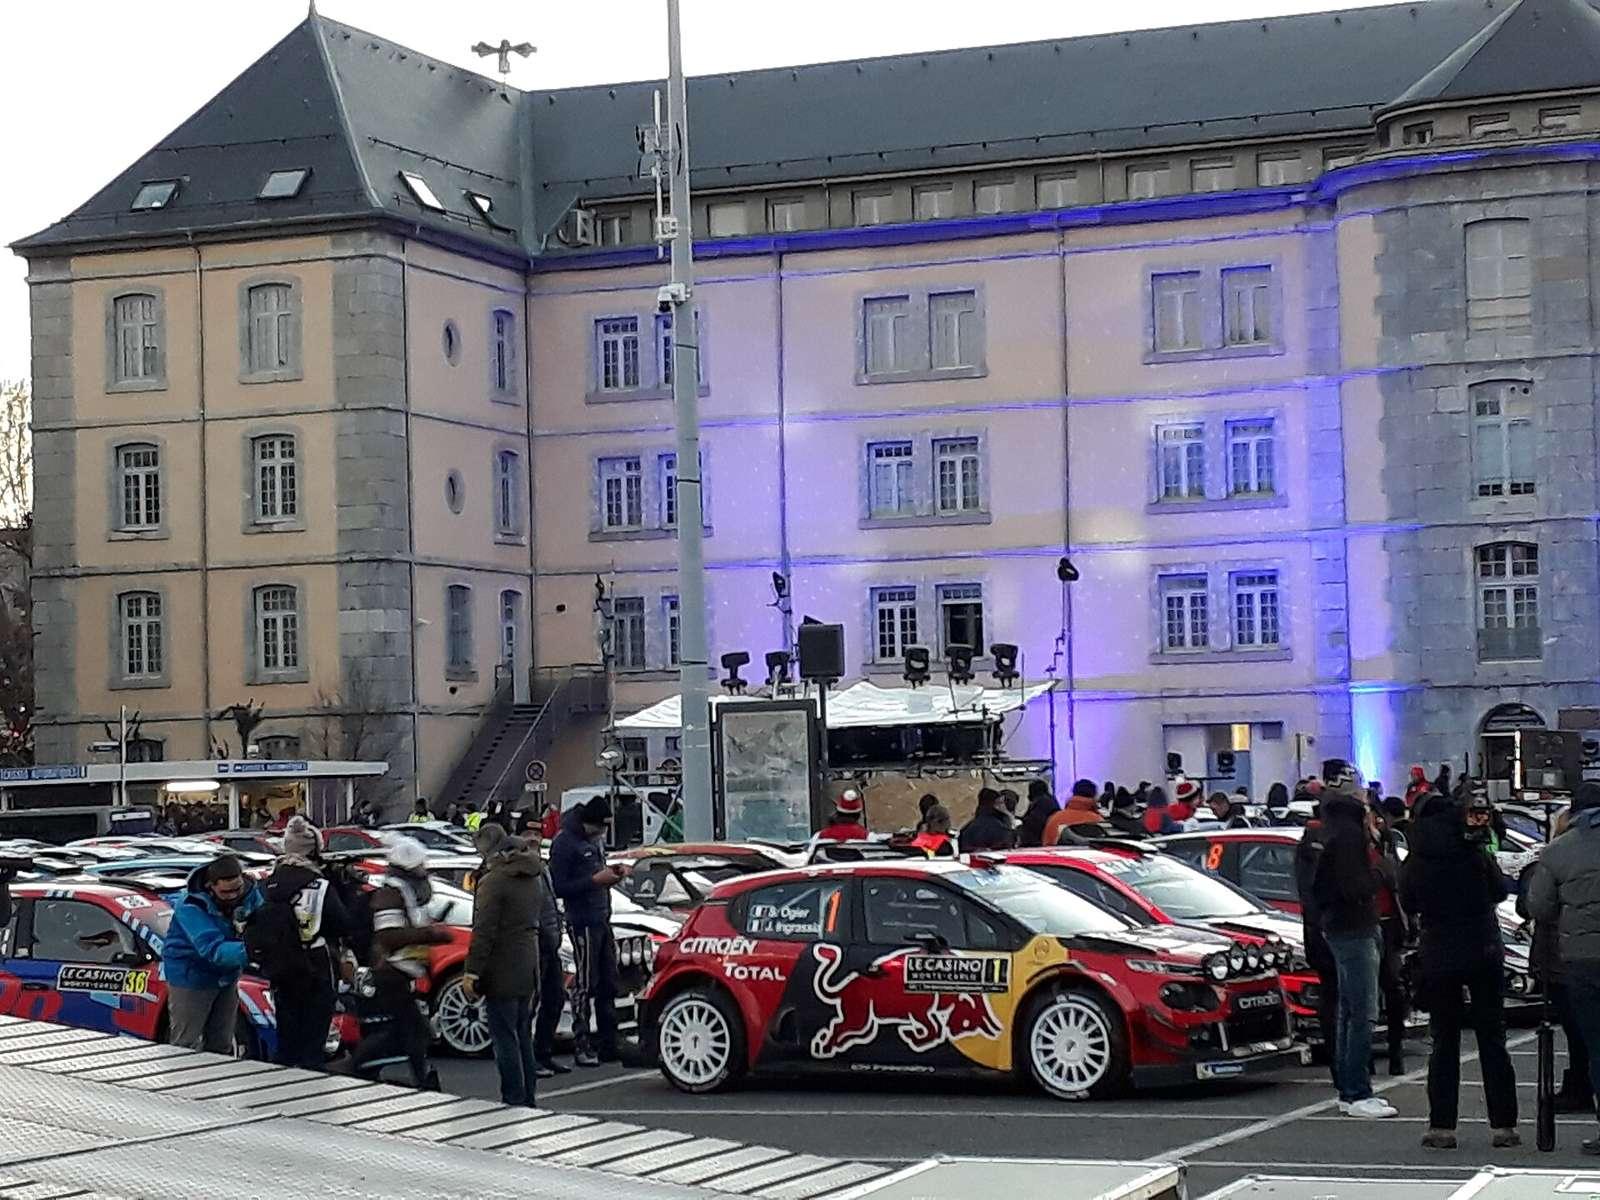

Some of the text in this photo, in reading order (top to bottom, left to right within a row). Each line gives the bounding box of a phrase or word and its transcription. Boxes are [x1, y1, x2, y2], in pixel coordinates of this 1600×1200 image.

[1205, 842, 1223, 870] 8
[780, 906, 810, 921] Ogier
[828, 891, 842, 933] 1
[680, 936, 758, 955] CITROËN
[722, 962, 786, 981] TOTAL
[924, 959, 981, 972] CASINO
[994, 958, 1001, 983] 1
[76, 969, 124, 982] CASINO
[126, 971, 147, 993] 36
